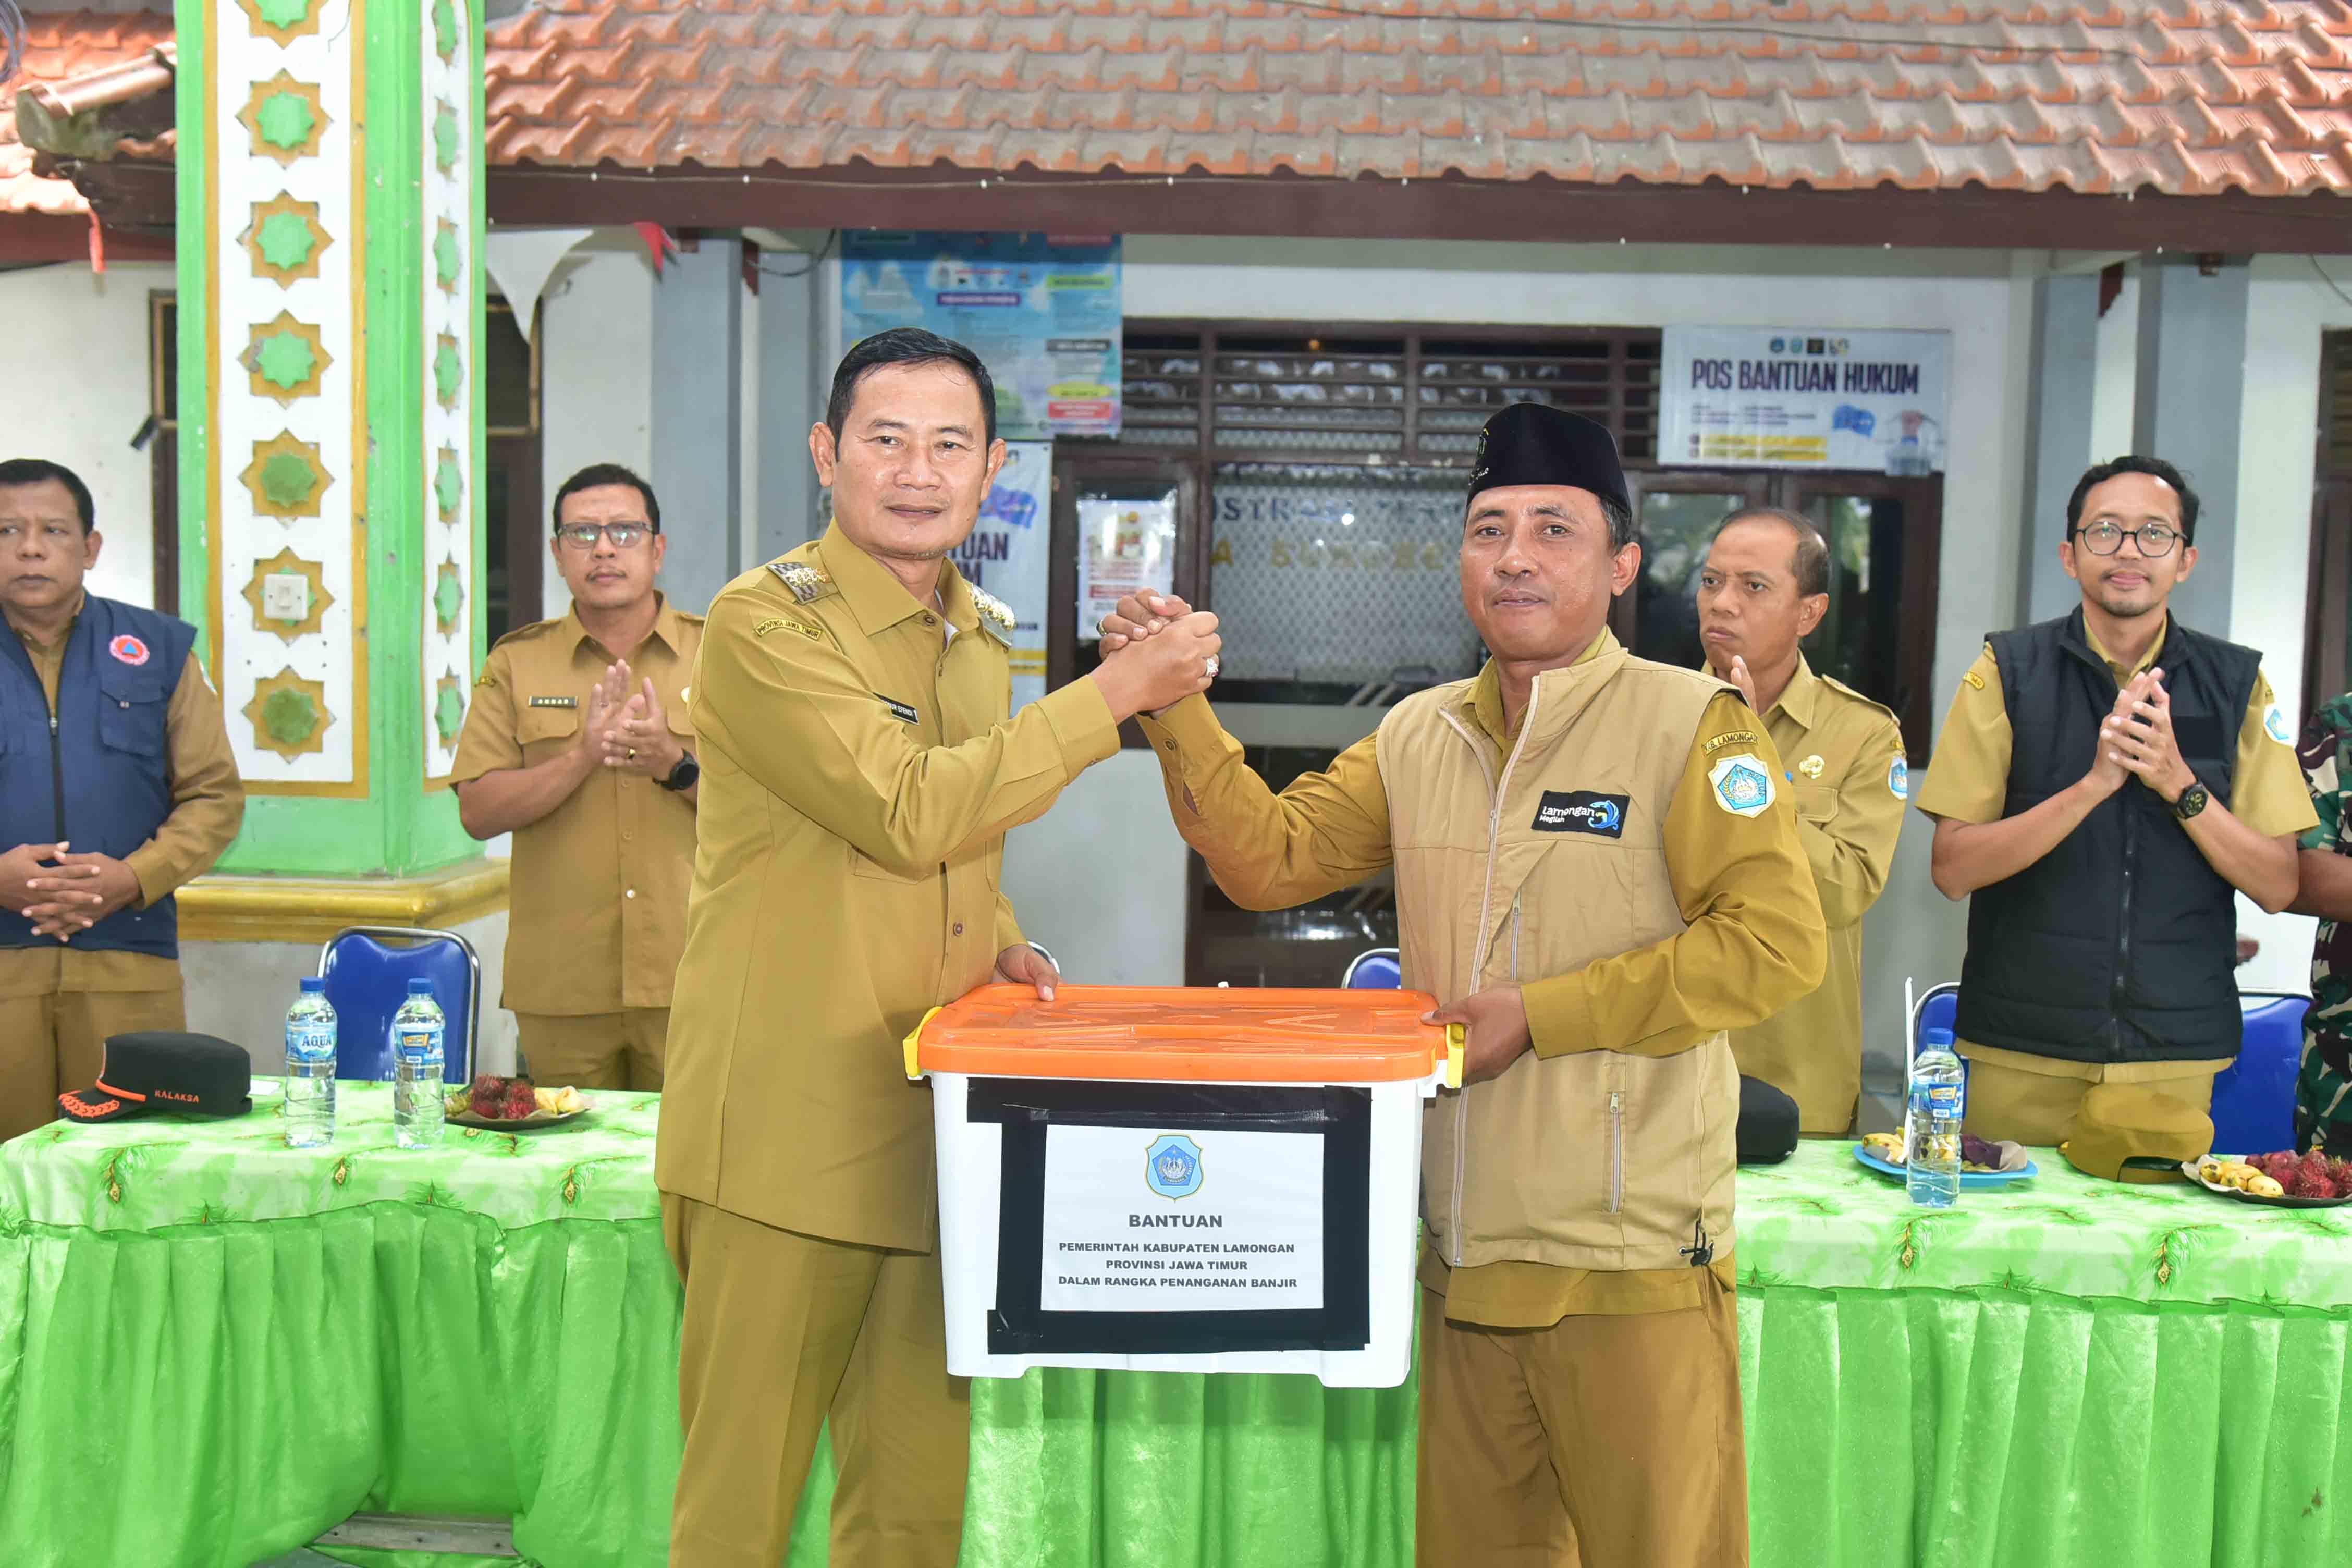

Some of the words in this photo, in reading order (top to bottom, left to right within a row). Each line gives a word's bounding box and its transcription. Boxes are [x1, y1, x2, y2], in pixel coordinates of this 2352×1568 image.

[1690, 359, 1732, 390] POS
[1738, 360, 1838, 393] BANTUAN
[1843, 362, 1921, 395] HUKUM
[1542, 805, 1595, 817] Lamongan
[301, 1035, 332, 1048] AQUA
[154, 1089, 200, 1104] KALAKSA
[1129, 1214, 1222, 1228] BANTUAN
[1059, 1242, 1140, 1253] PEMERINTAH
[1143, 1243, 1220, 1253] KABUPATEN
[1223, 1243, 1295, 1253] LAMONGAN
[1106, 1260, 1165, 1270] PROVINSI
[1168, 1260, 1204, 1270] JAWA
[1207, 1260, 1248, 1270] TIMUR
[1058, 1276, 1101, 1286] DALAM
[1104, 1277, 1157, 1287] RANGKA
[1160, 1278, 1247, 1288] PENANGANAN
[1251, 1279, 1297, 1288] BANJIR
